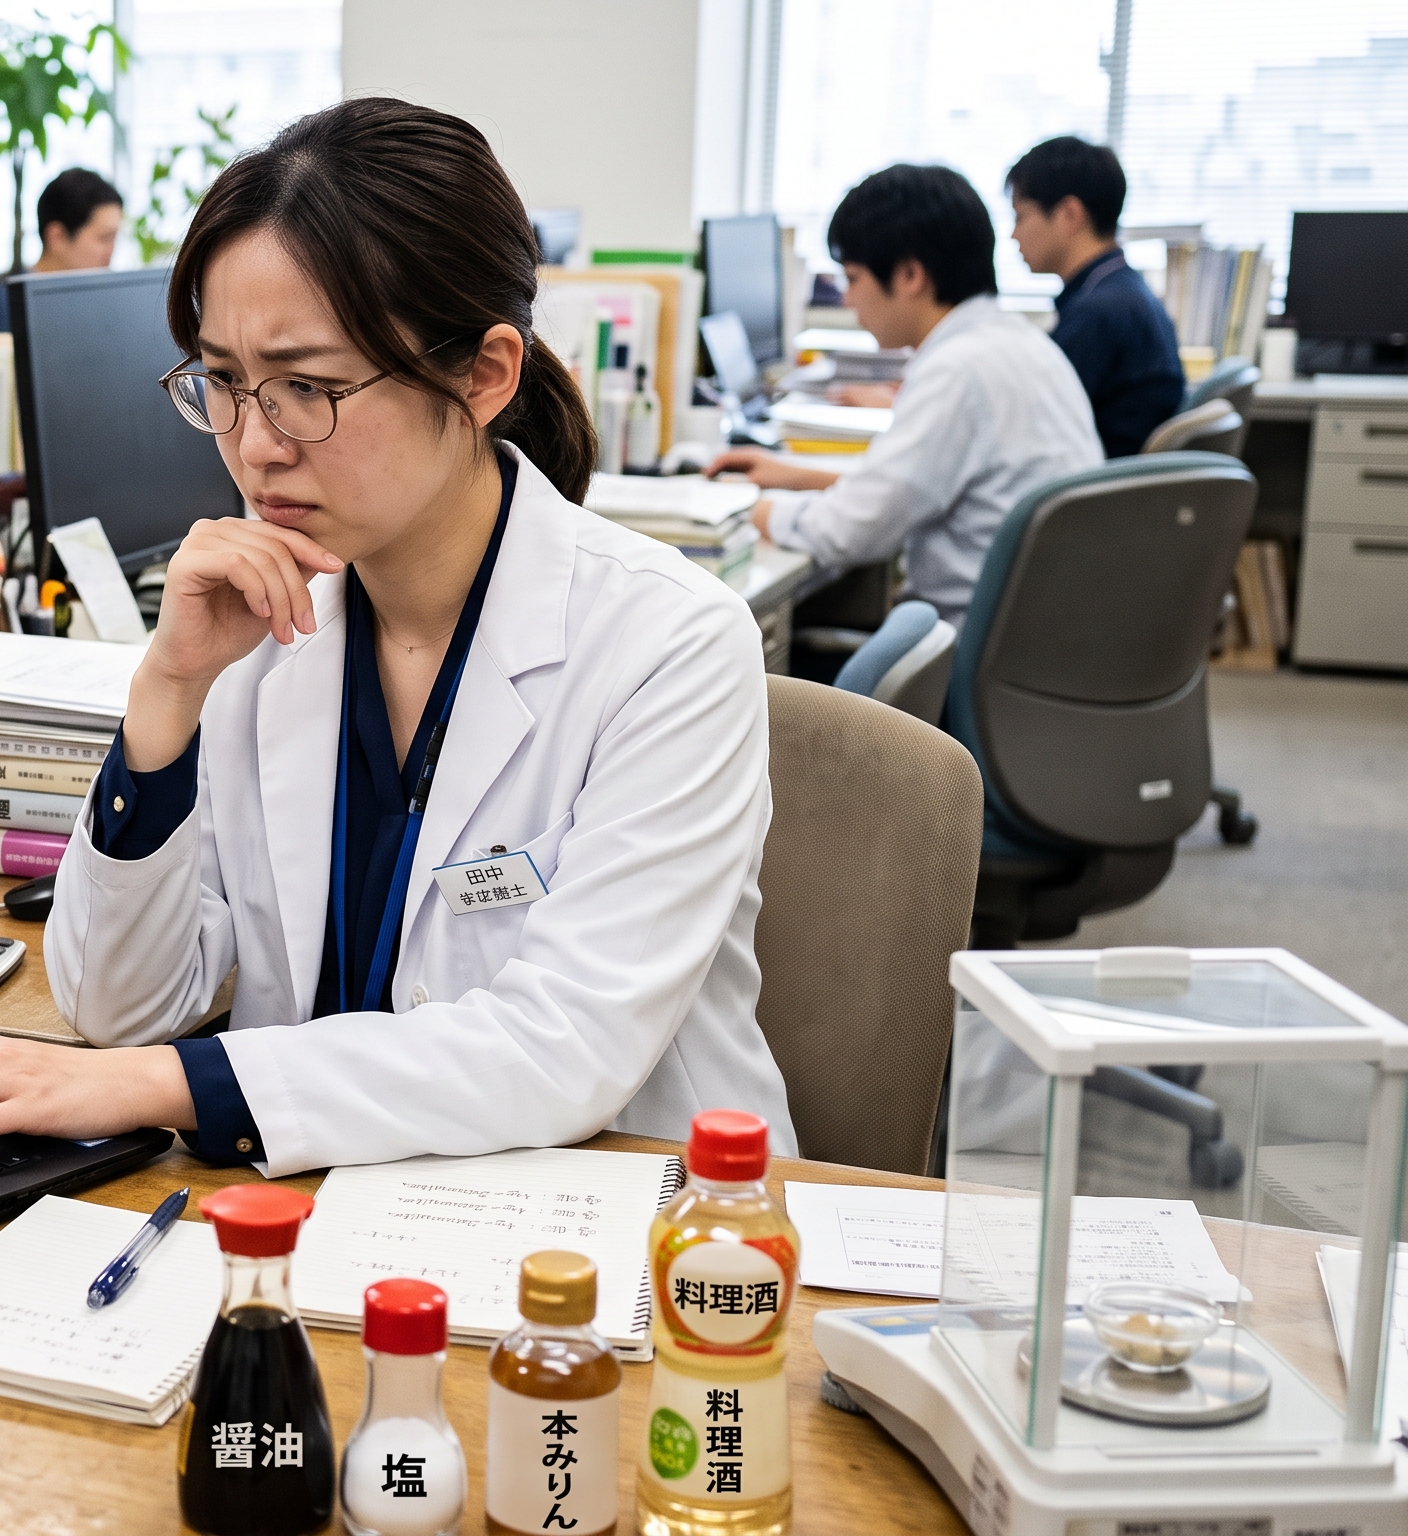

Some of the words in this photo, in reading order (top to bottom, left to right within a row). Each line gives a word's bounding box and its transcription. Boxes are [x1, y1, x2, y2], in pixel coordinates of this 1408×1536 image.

[465, 865, 504, 885] 田中
[673, 1276, 780, 1316] 料理酒
[210, 1421, 305, 1470] 醤油
[705, 1388, 744, 1493] 料理酒
[380, 1452, 429, 1499] 塩
[541, 1408, 579, 1530] 本みりん
